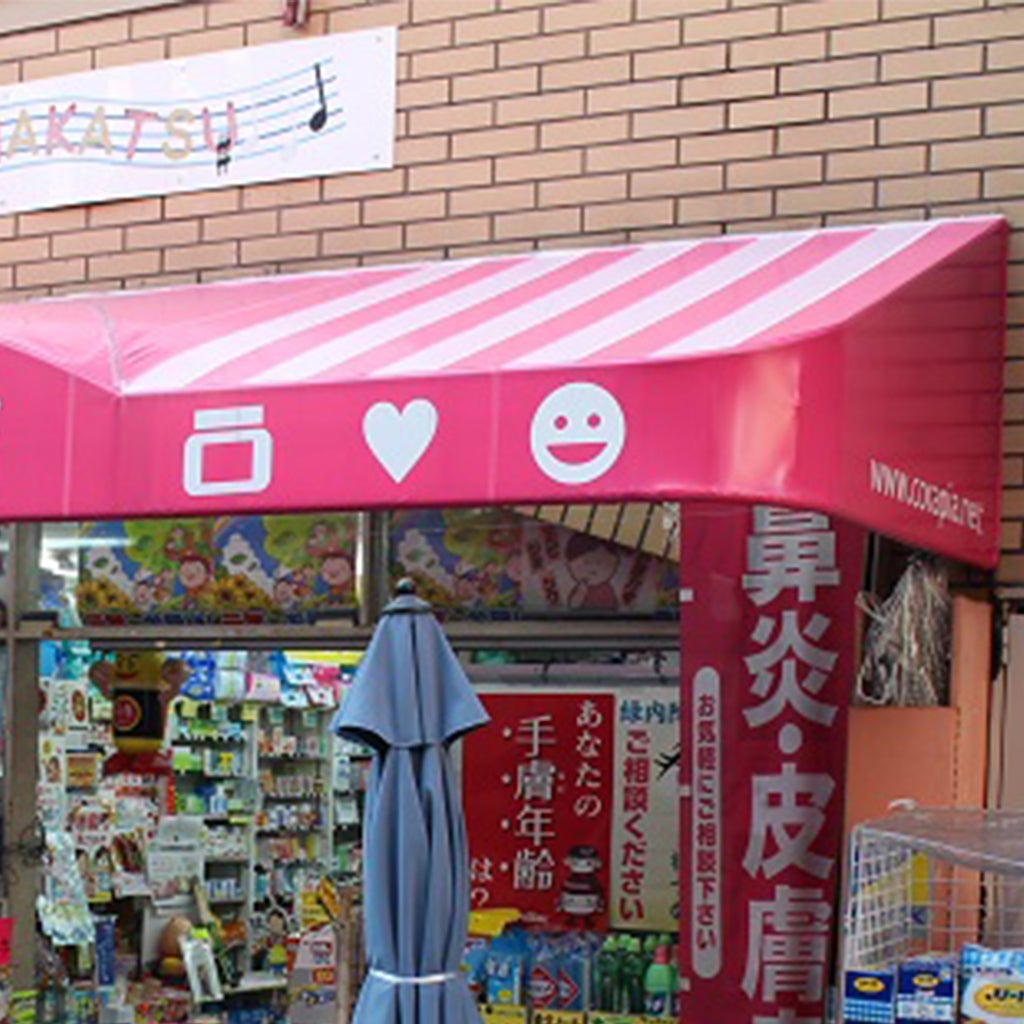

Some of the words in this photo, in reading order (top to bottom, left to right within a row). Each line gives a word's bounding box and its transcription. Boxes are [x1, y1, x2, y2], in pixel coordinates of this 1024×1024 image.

[574, 699, 603, 818] あなたの
[618, 728, 650, 921] ご相談ください
